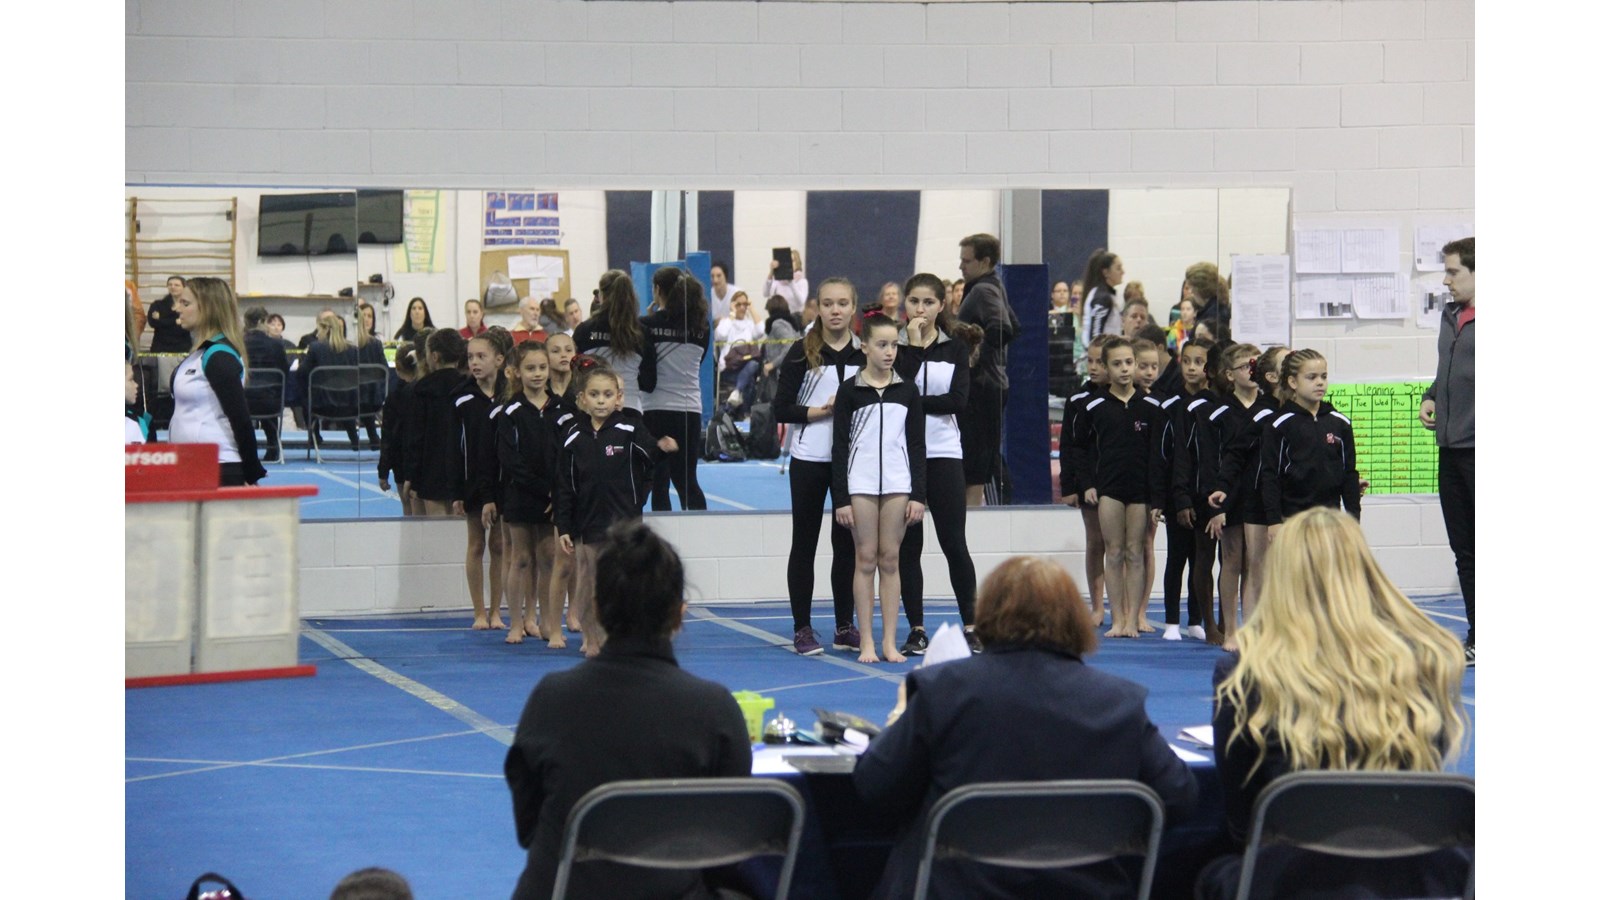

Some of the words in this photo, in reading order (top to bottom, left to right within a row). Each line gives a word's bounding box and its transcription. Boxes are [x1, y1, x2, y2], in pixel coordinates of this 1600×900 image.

[1334, 400, 1350, 408] Mon
[1354, 397, 1368, 407] Tue
[1374, 397, 1389, 406] Wed
[1391, 397, 1405, 407] Thu
